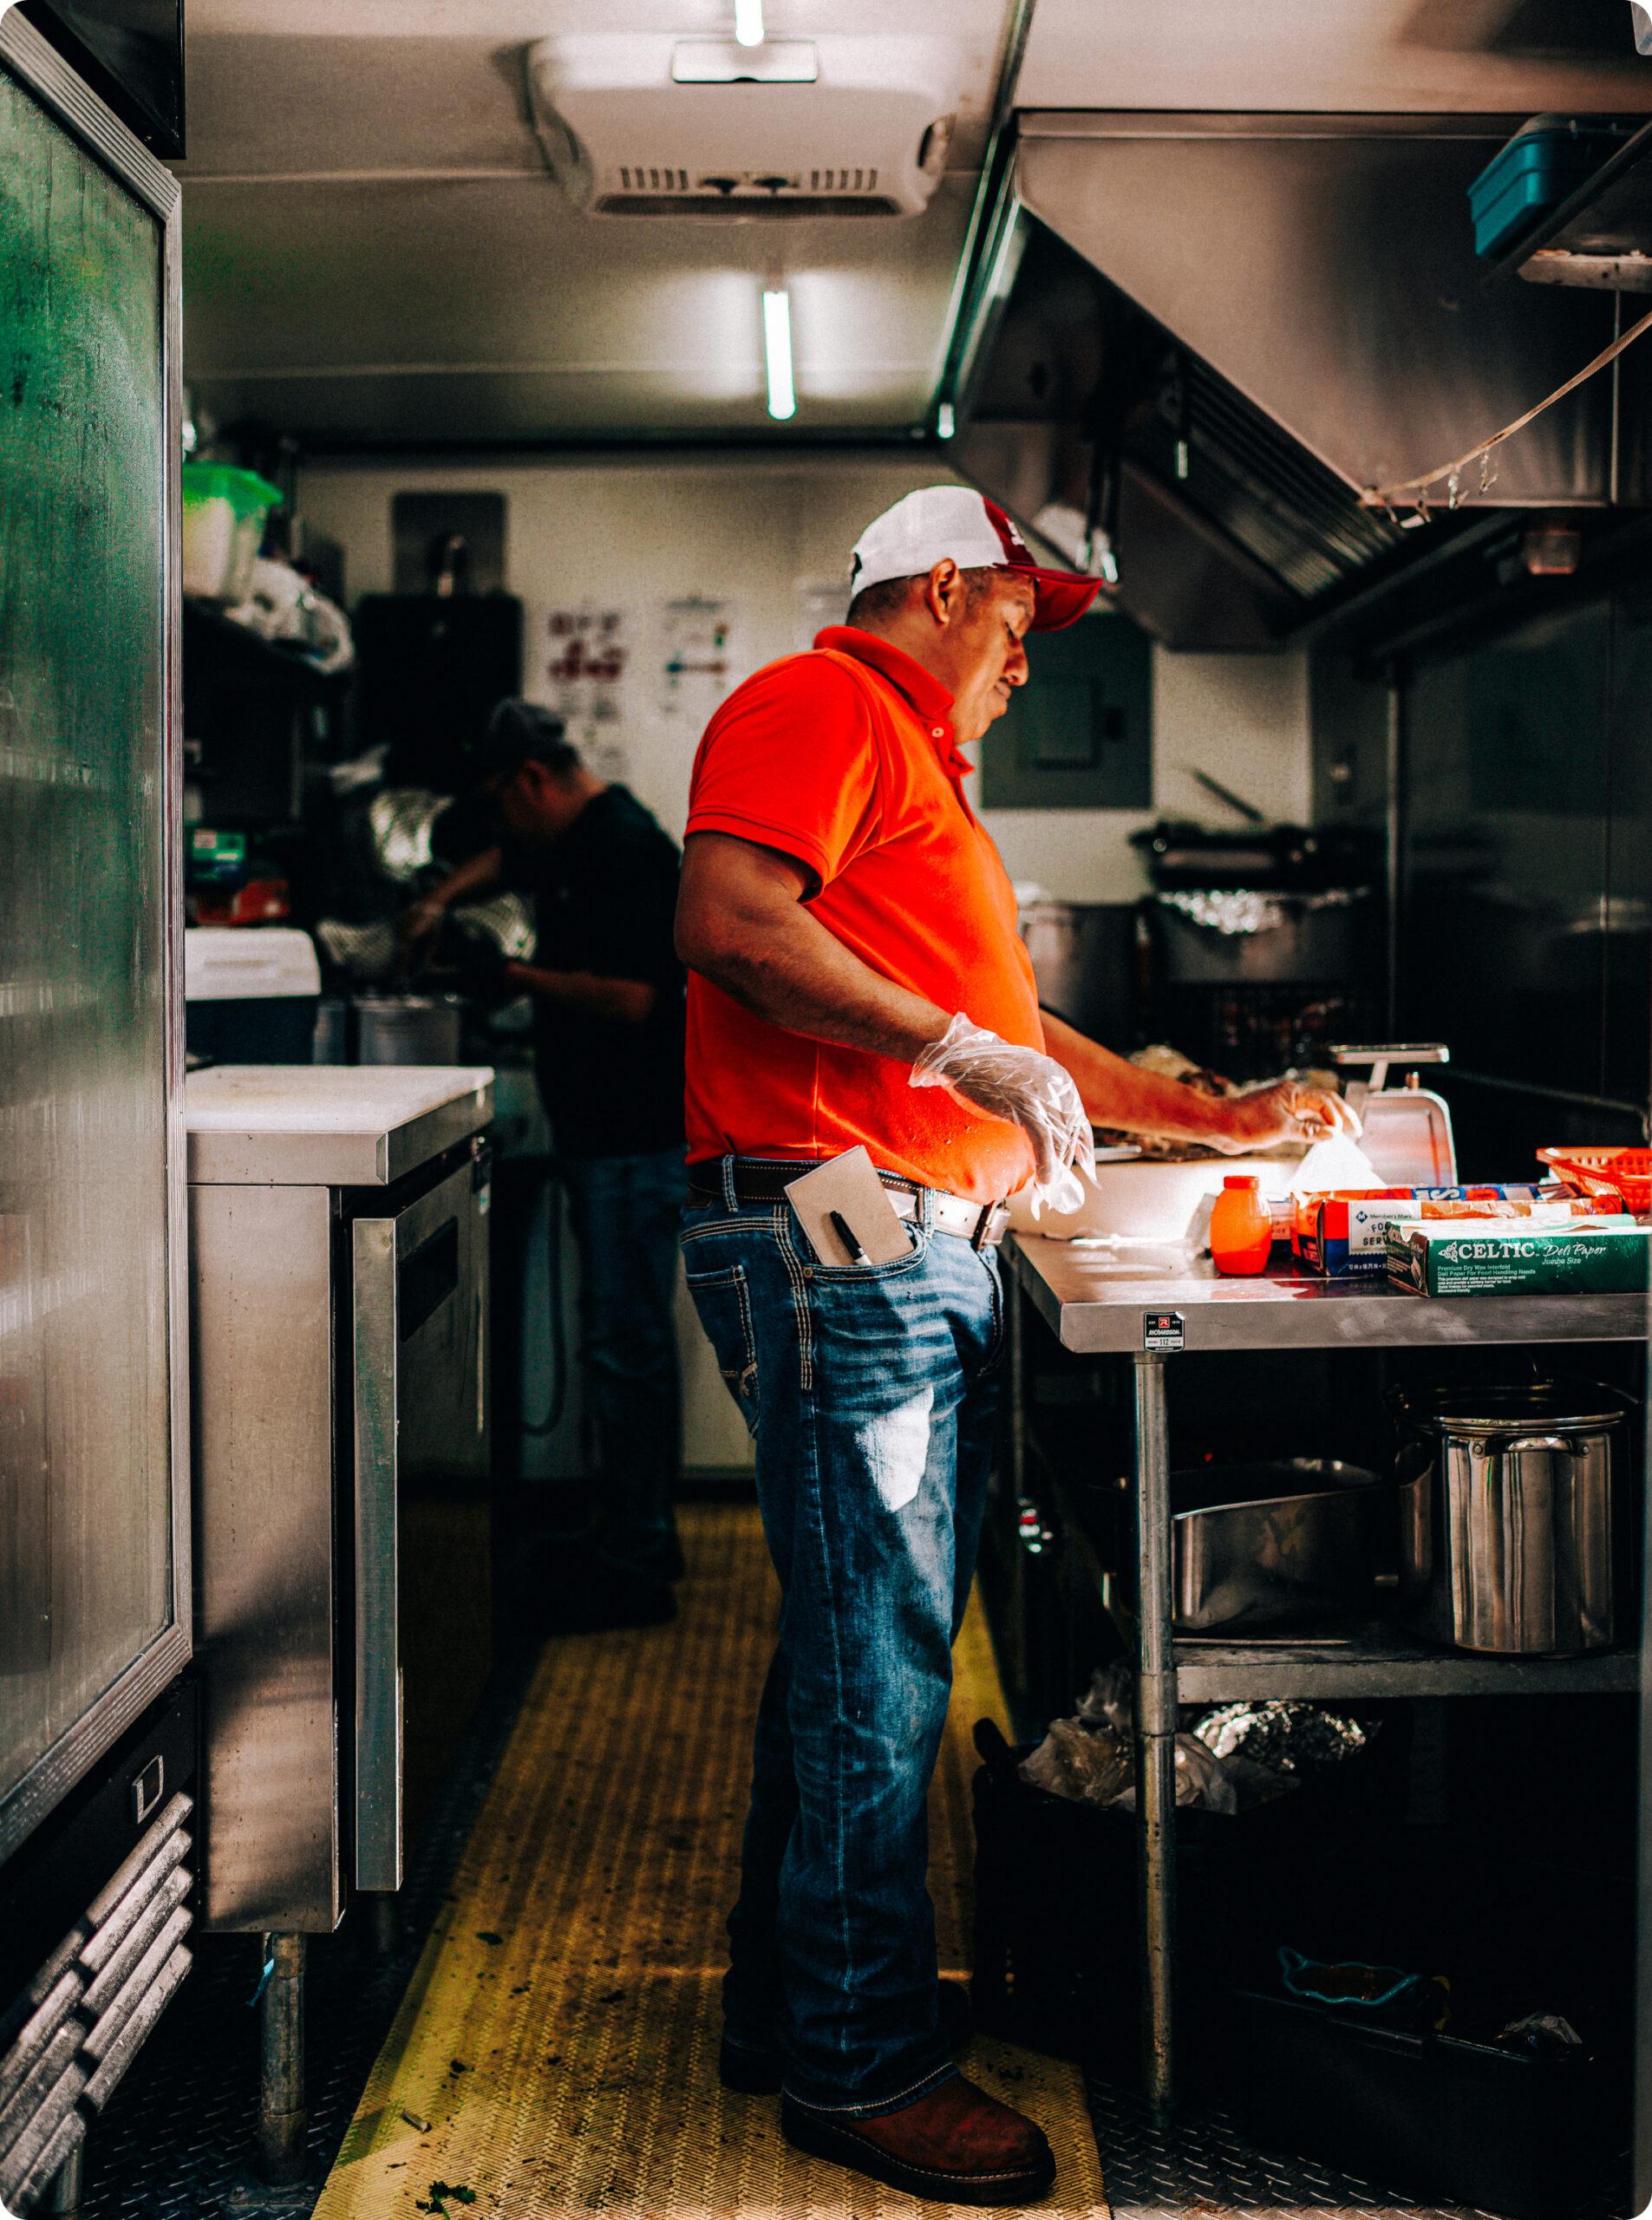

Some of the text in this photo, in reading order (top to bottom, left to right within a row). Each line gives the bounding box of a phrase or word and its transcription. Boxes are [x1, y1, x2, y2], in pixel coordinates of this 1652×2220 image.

[1458, 1242, 1535, 1259] CELTIC
[1543, 1243, 1607, 1259] Deli Paper
